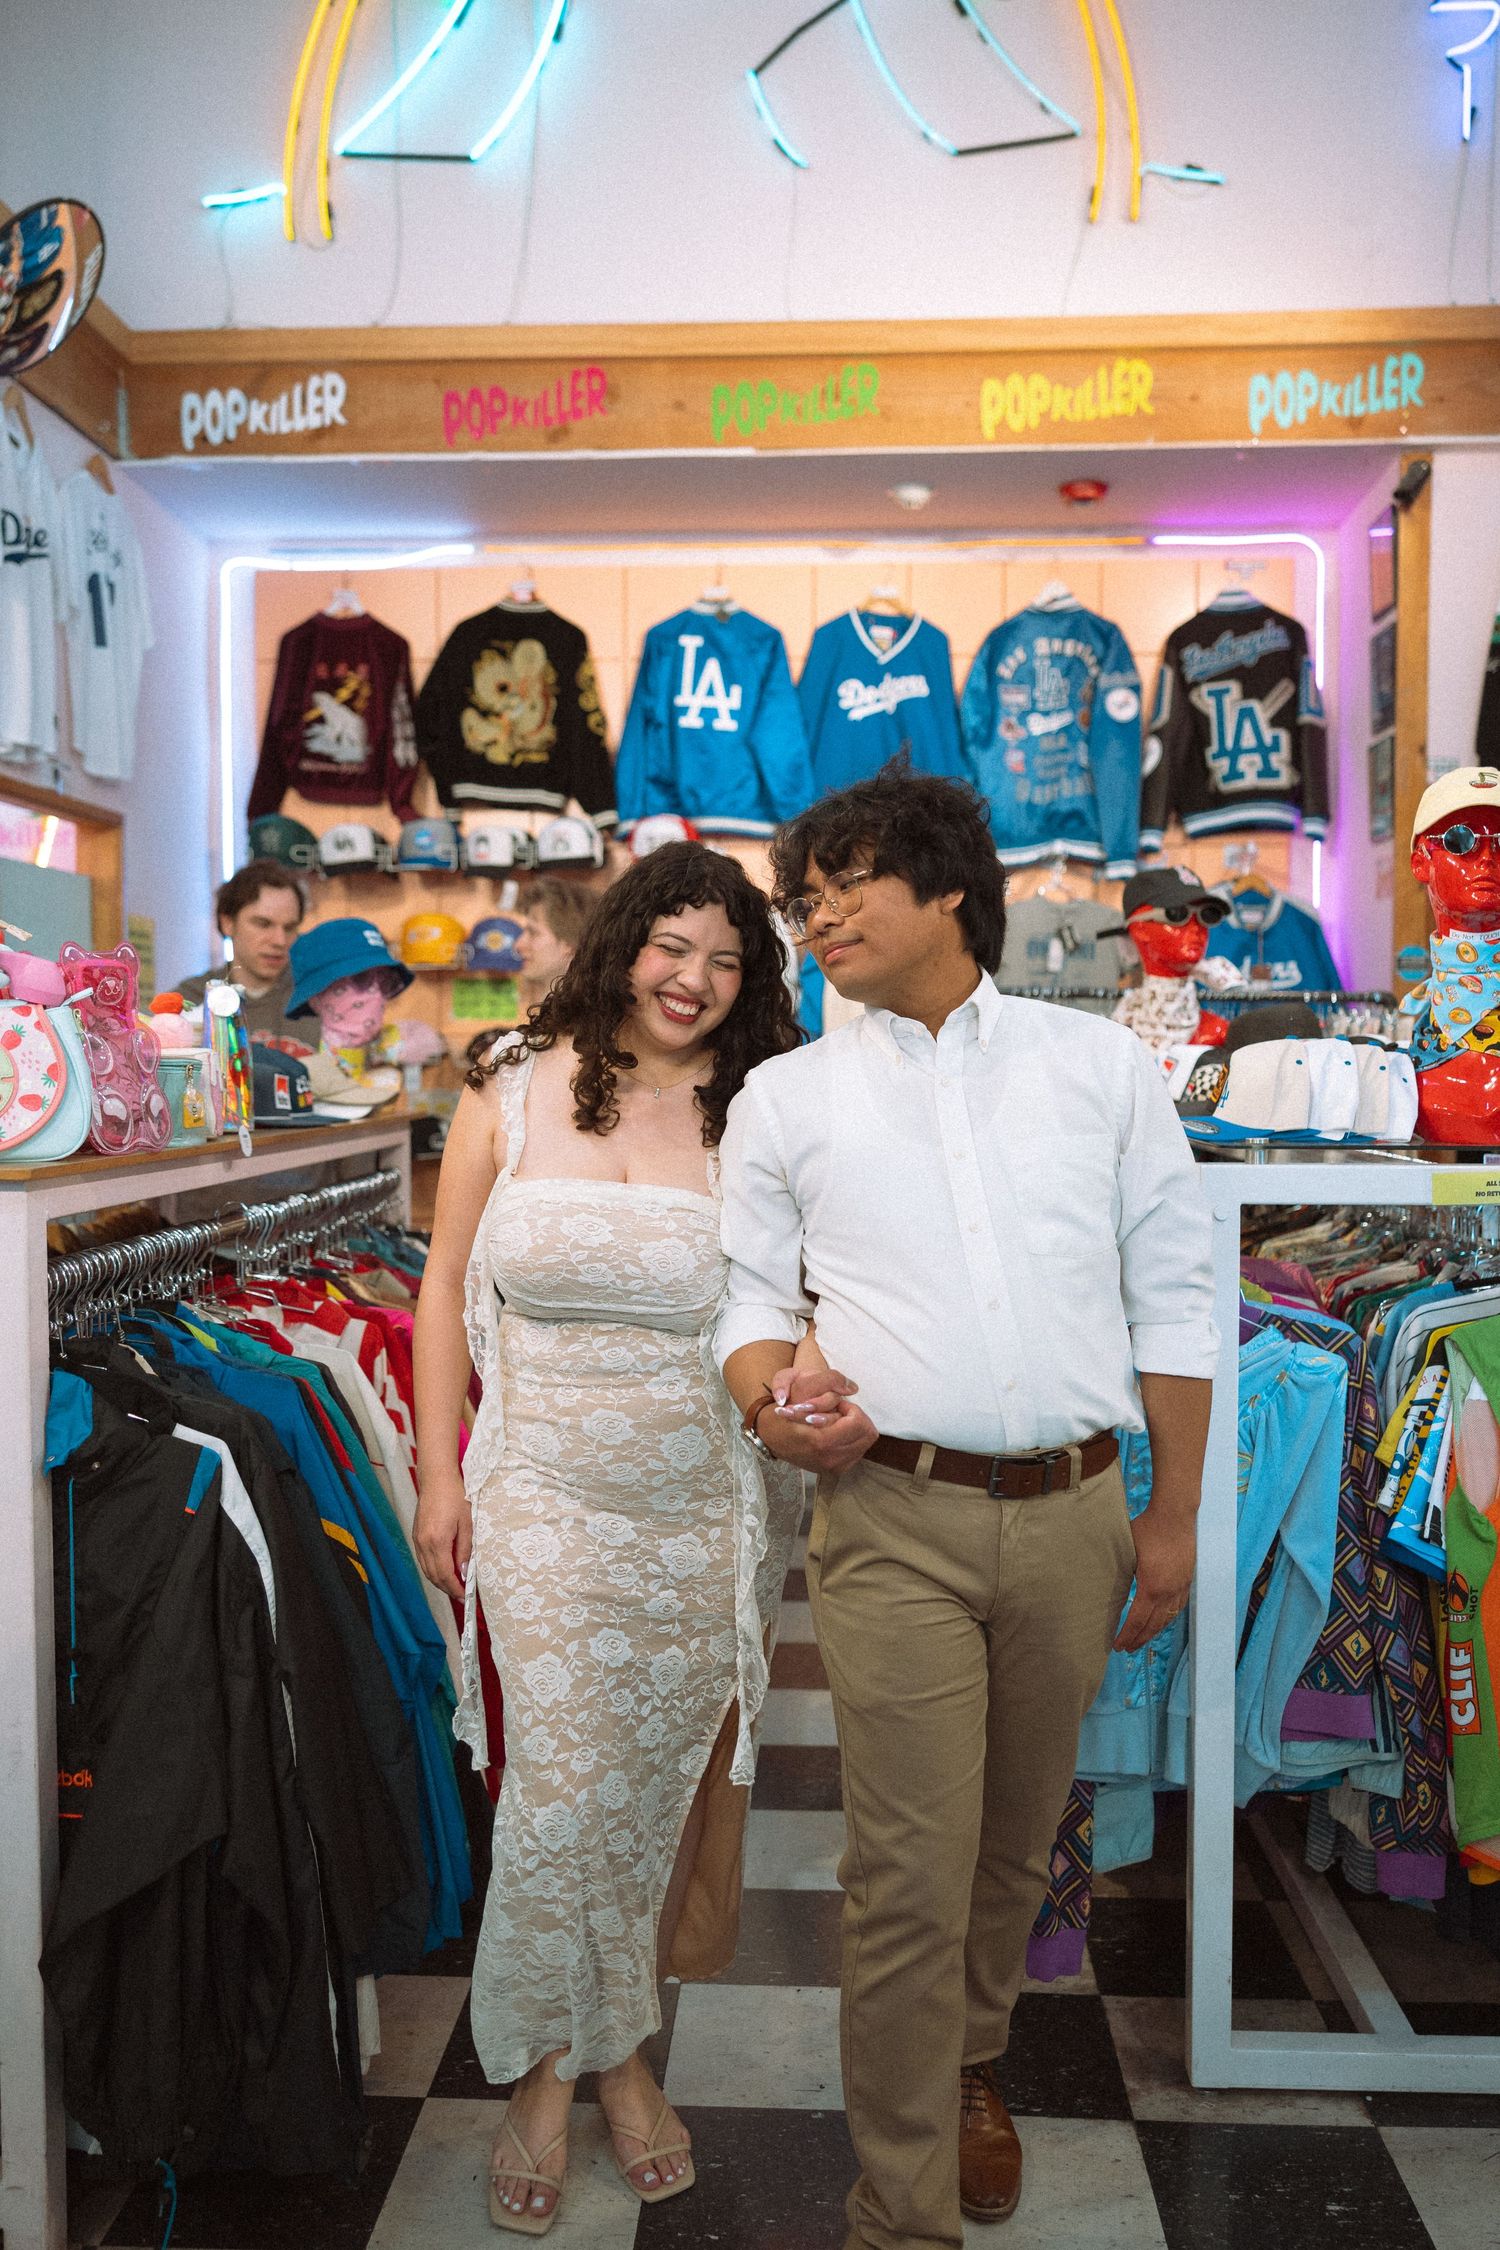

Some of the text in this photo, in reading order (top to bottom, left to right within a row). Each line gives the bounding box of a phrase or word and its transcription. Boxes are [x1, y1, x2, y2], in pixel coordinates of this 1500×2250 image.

[673, 634, 743, 732] LA
[1206, 686, 1282, 784] LA
[1450, 1647, 1477, 1727] CLIF
